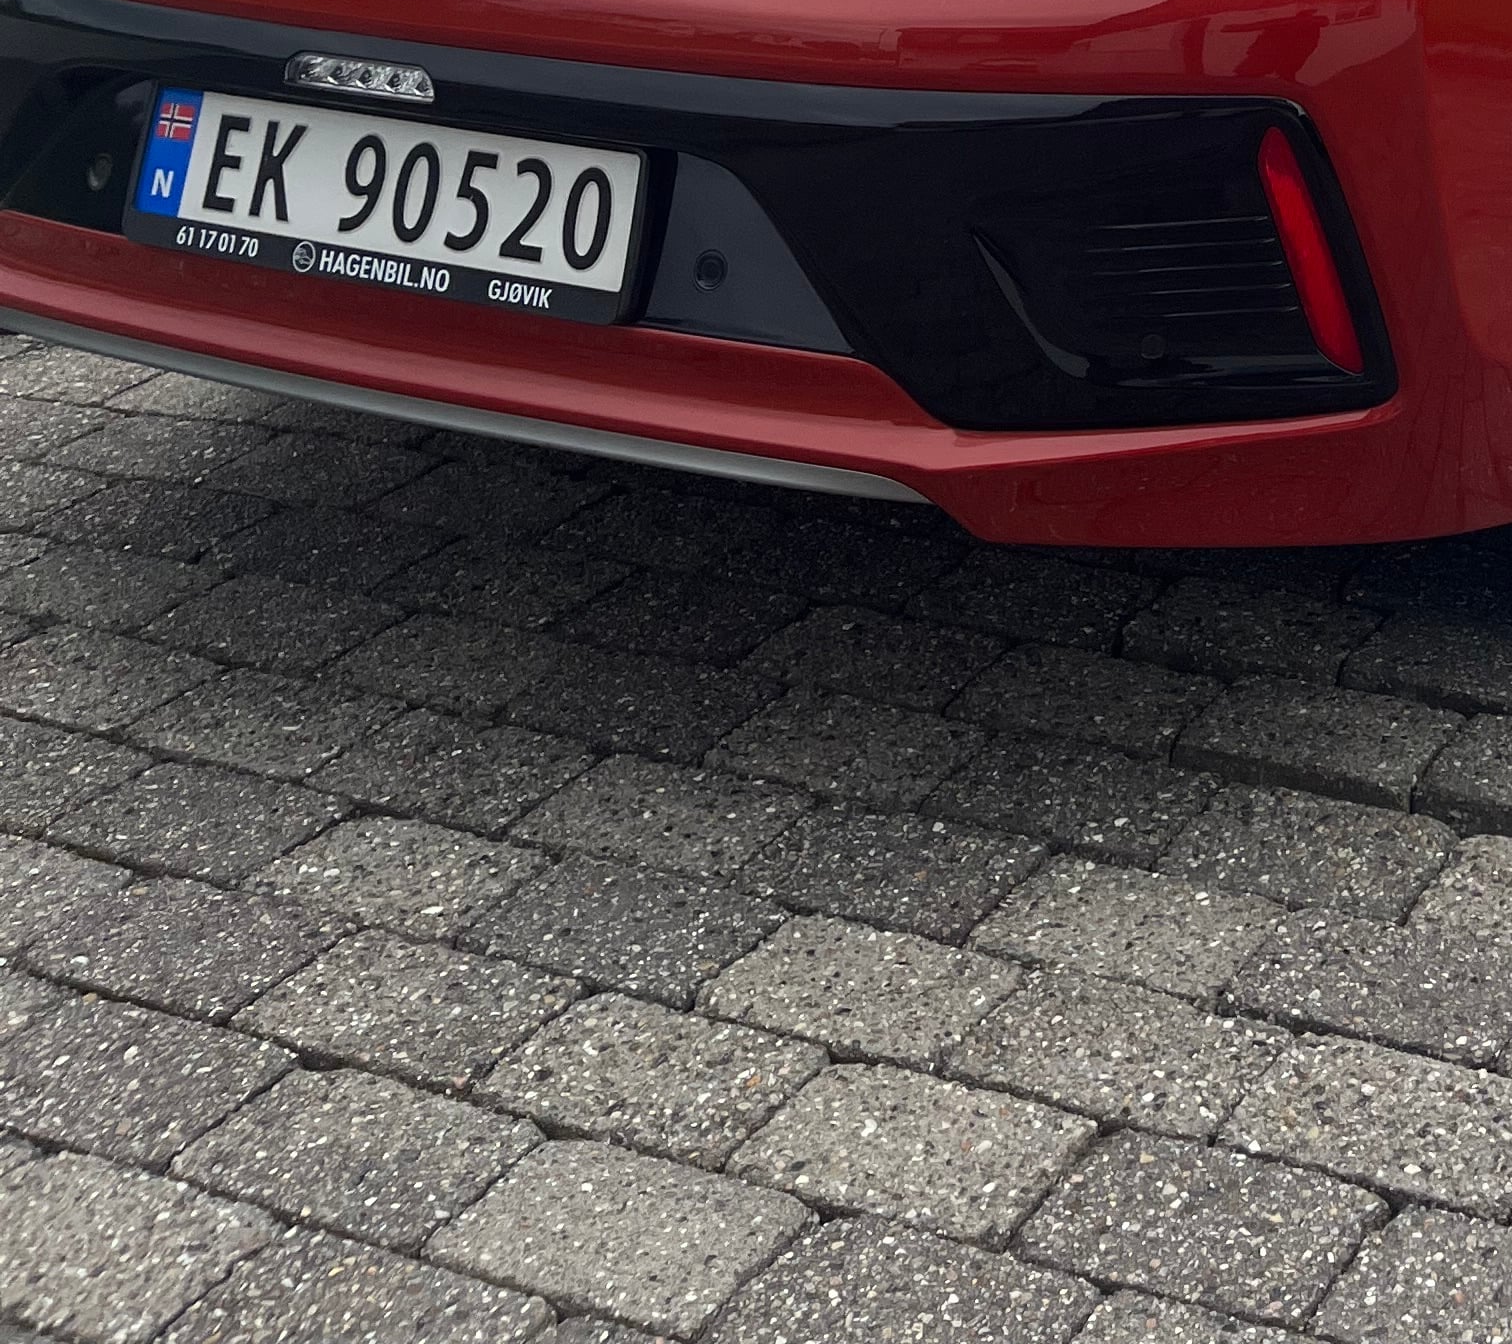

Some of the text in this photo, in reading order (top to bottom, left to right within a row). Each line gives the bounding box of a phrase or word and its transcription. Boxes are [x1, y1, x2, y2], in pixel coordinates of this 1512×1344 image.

[151, 169, 173, 199] N
[201, 113, 613, 272] EK 90520
[318, 248, 451, 293] HAGENBIL.NO
[487, 280, 553, 310] GJØVIK
